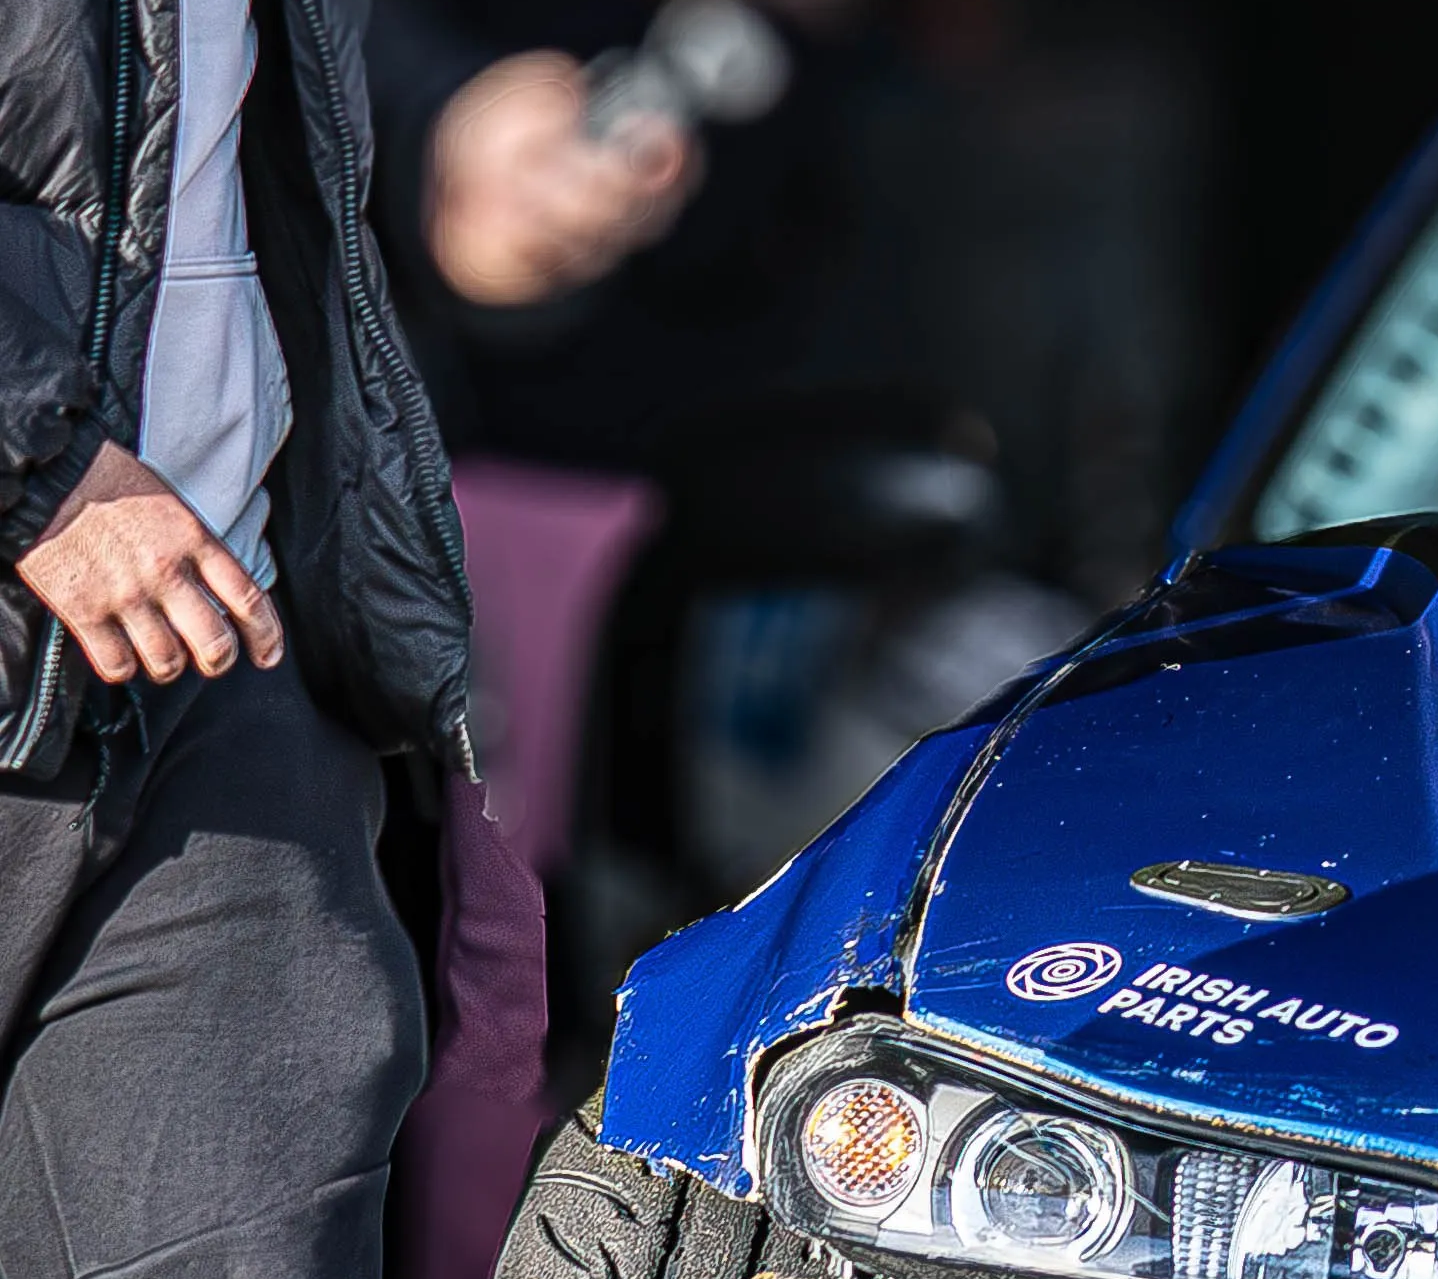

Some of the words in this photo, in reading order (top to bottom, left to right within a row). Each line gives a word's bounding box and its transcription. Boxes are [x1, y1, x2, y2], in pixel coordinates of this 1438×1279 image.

[1097, 988, 1255, 1046] PARTS
[1133, 962, 1268, 1016] IRISH
[1257, 997, 1400, 1049] AUTO
